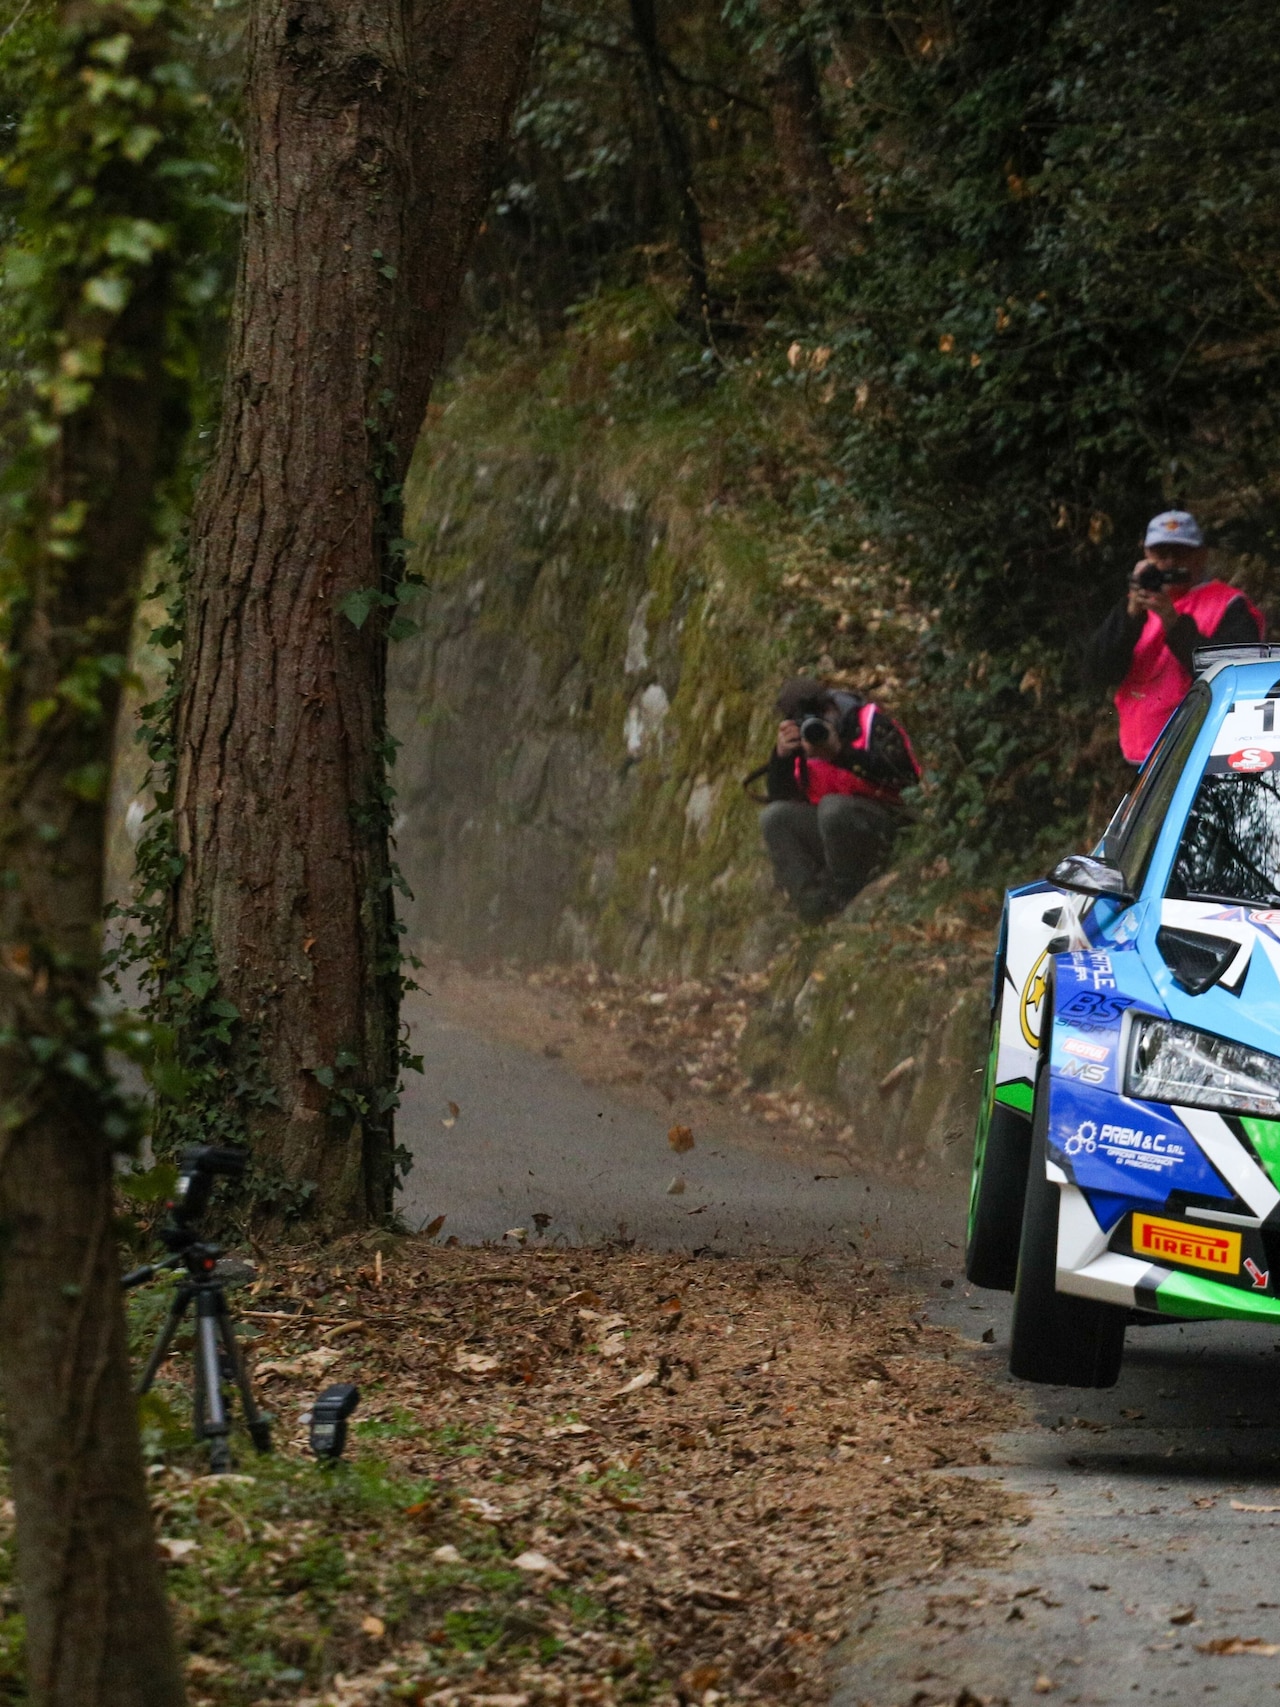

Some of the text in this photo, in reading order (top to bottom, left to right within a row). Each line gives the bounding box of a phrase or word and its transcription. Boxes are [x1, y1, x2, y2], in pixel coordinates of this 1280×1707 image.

[1058, 991, 1136, 1023] BS
[1055, 1017, 1118, 1034] SPORT
[1060, 1059, 1109, 1083] MS
[1099, 1124, 1143, 1148] PREMI
[1142, 1135, 1152, 1150] &
[1142, 1223, 1230, 1264] PIRELLI
